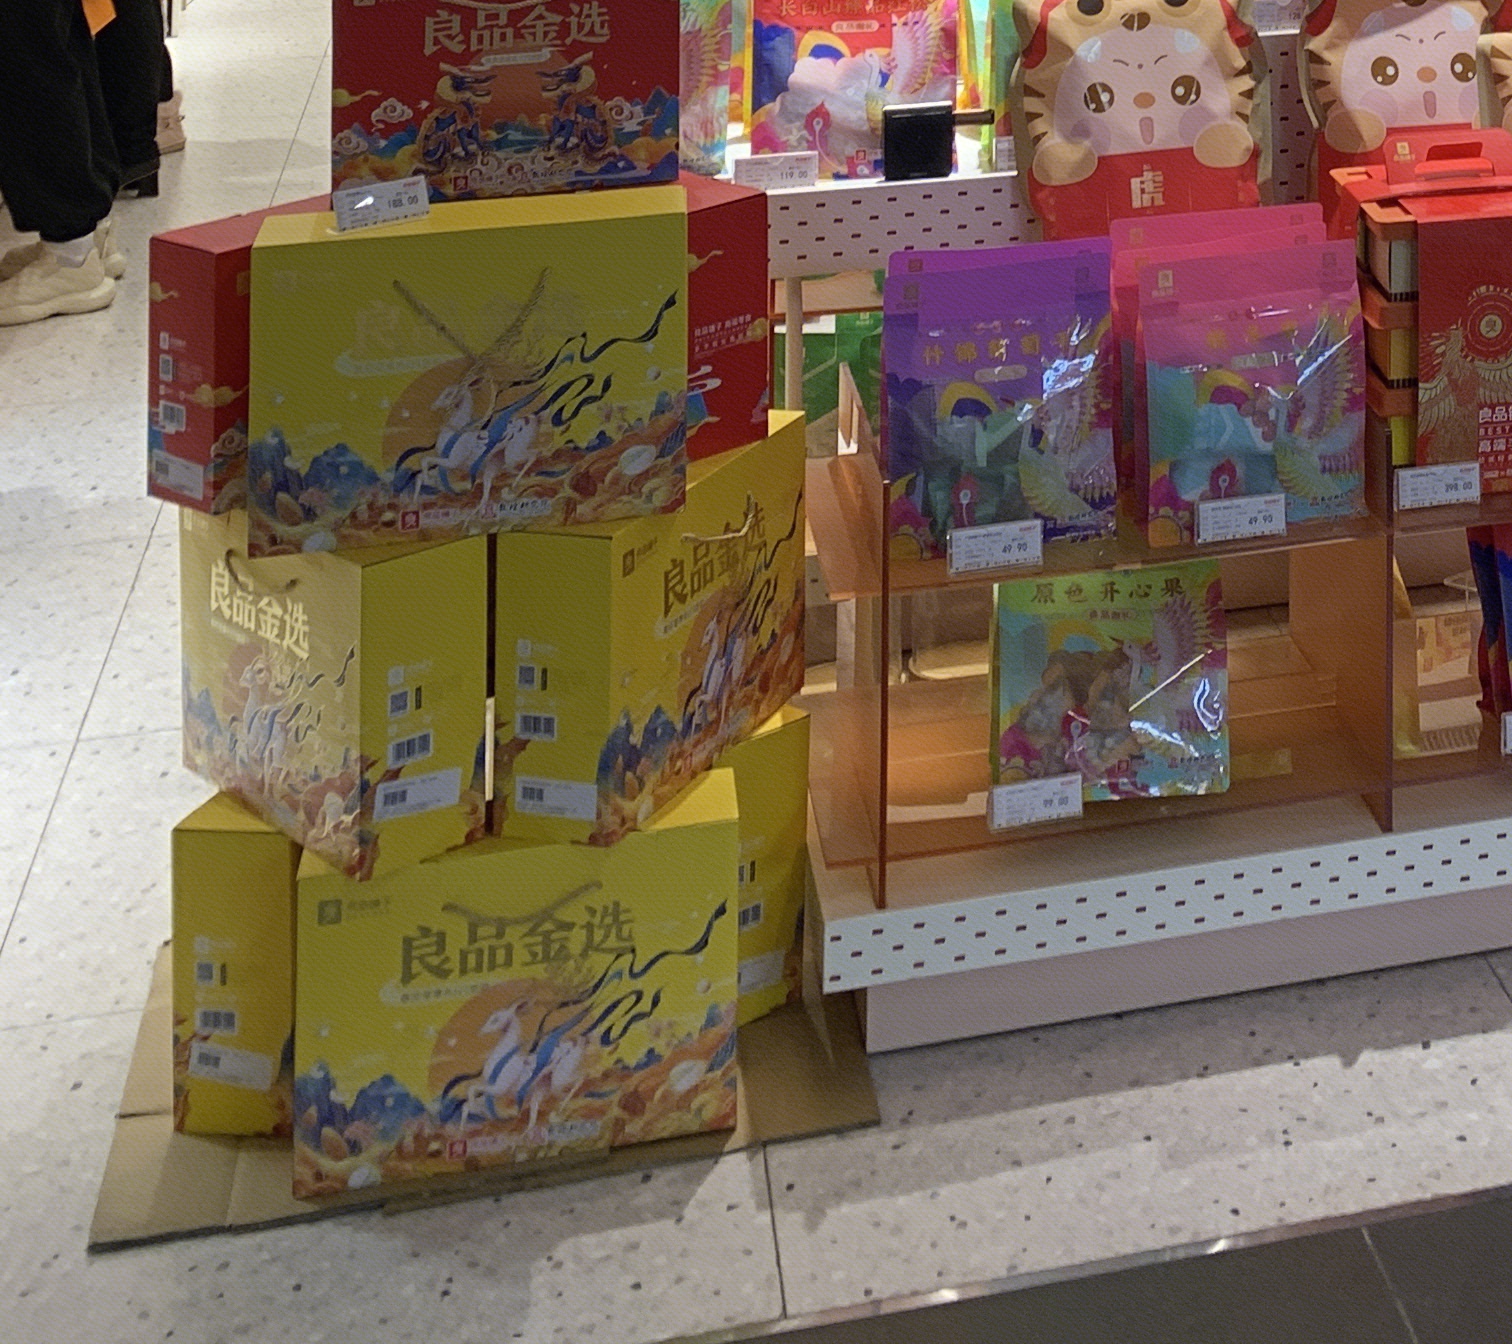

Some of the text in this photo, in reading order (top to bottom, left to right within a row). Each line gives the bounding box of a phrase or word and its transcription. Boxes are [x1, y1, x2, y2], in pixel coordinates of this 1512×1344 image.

[423, 0, 611, 57] 良品金选
[209, 558, 310, 658] 良品金选
[1031, 576, 1187, 604] 原色开心果
[400, 900, 636, 987] 良品金选
